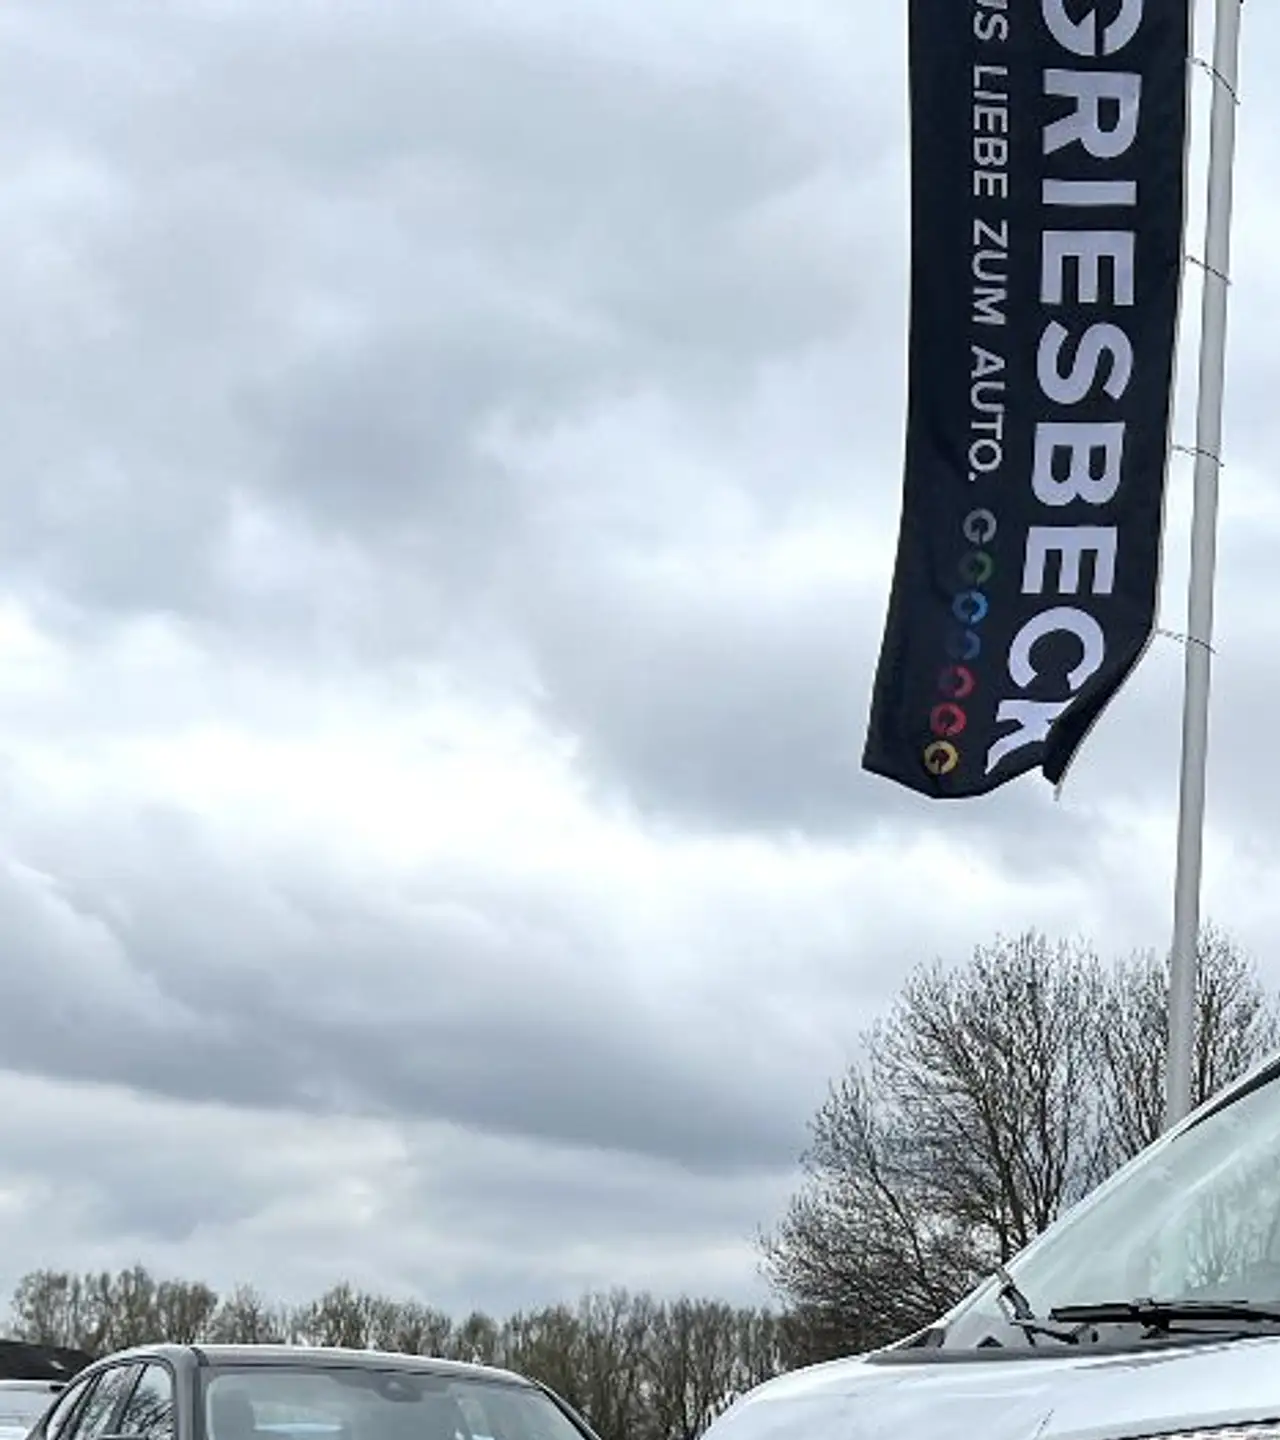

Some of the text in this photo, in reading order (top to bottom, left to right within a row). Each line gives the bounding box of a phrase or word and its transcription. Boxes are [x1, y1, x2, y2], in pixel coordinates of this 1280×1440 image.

[973, 65, 1008, 199] LIEBE
[972, 219, 1008, 325] ZUM
[968, 345, 1006, 482] AUTO.
